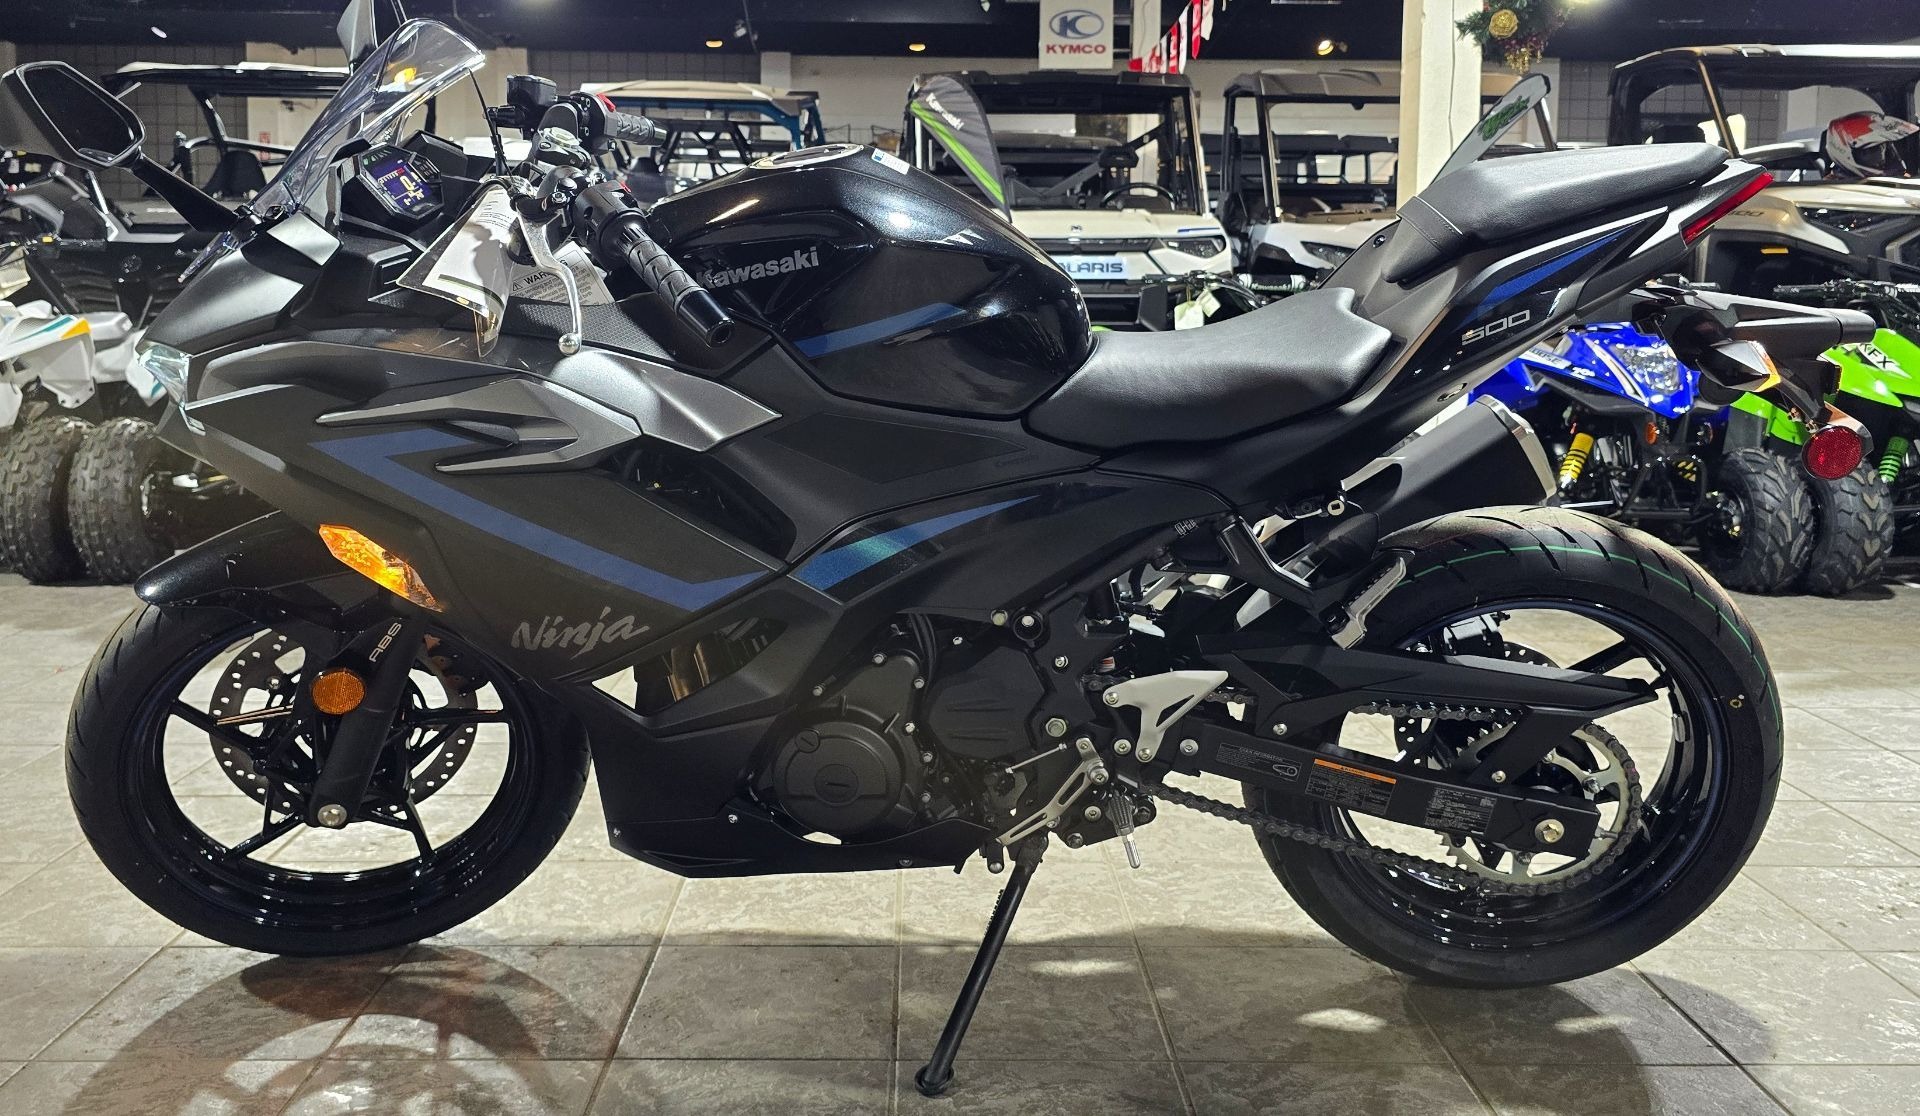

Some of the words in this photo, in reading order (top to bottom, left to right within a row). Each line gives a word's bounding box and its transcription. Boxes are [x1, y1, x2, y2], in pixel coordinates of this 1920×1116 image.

[1046, 44, 1106, 54] KYMCO
[524, 259, 568, 285] WARG
[696, 246, 819, 289] Kawasaki
[1059, 262, 1123, 273] LARIS
[1461, 309, 1530, 346] 500
[369, 622, 402, 663] ABS
[510, 606, 649, 660] Ninja
